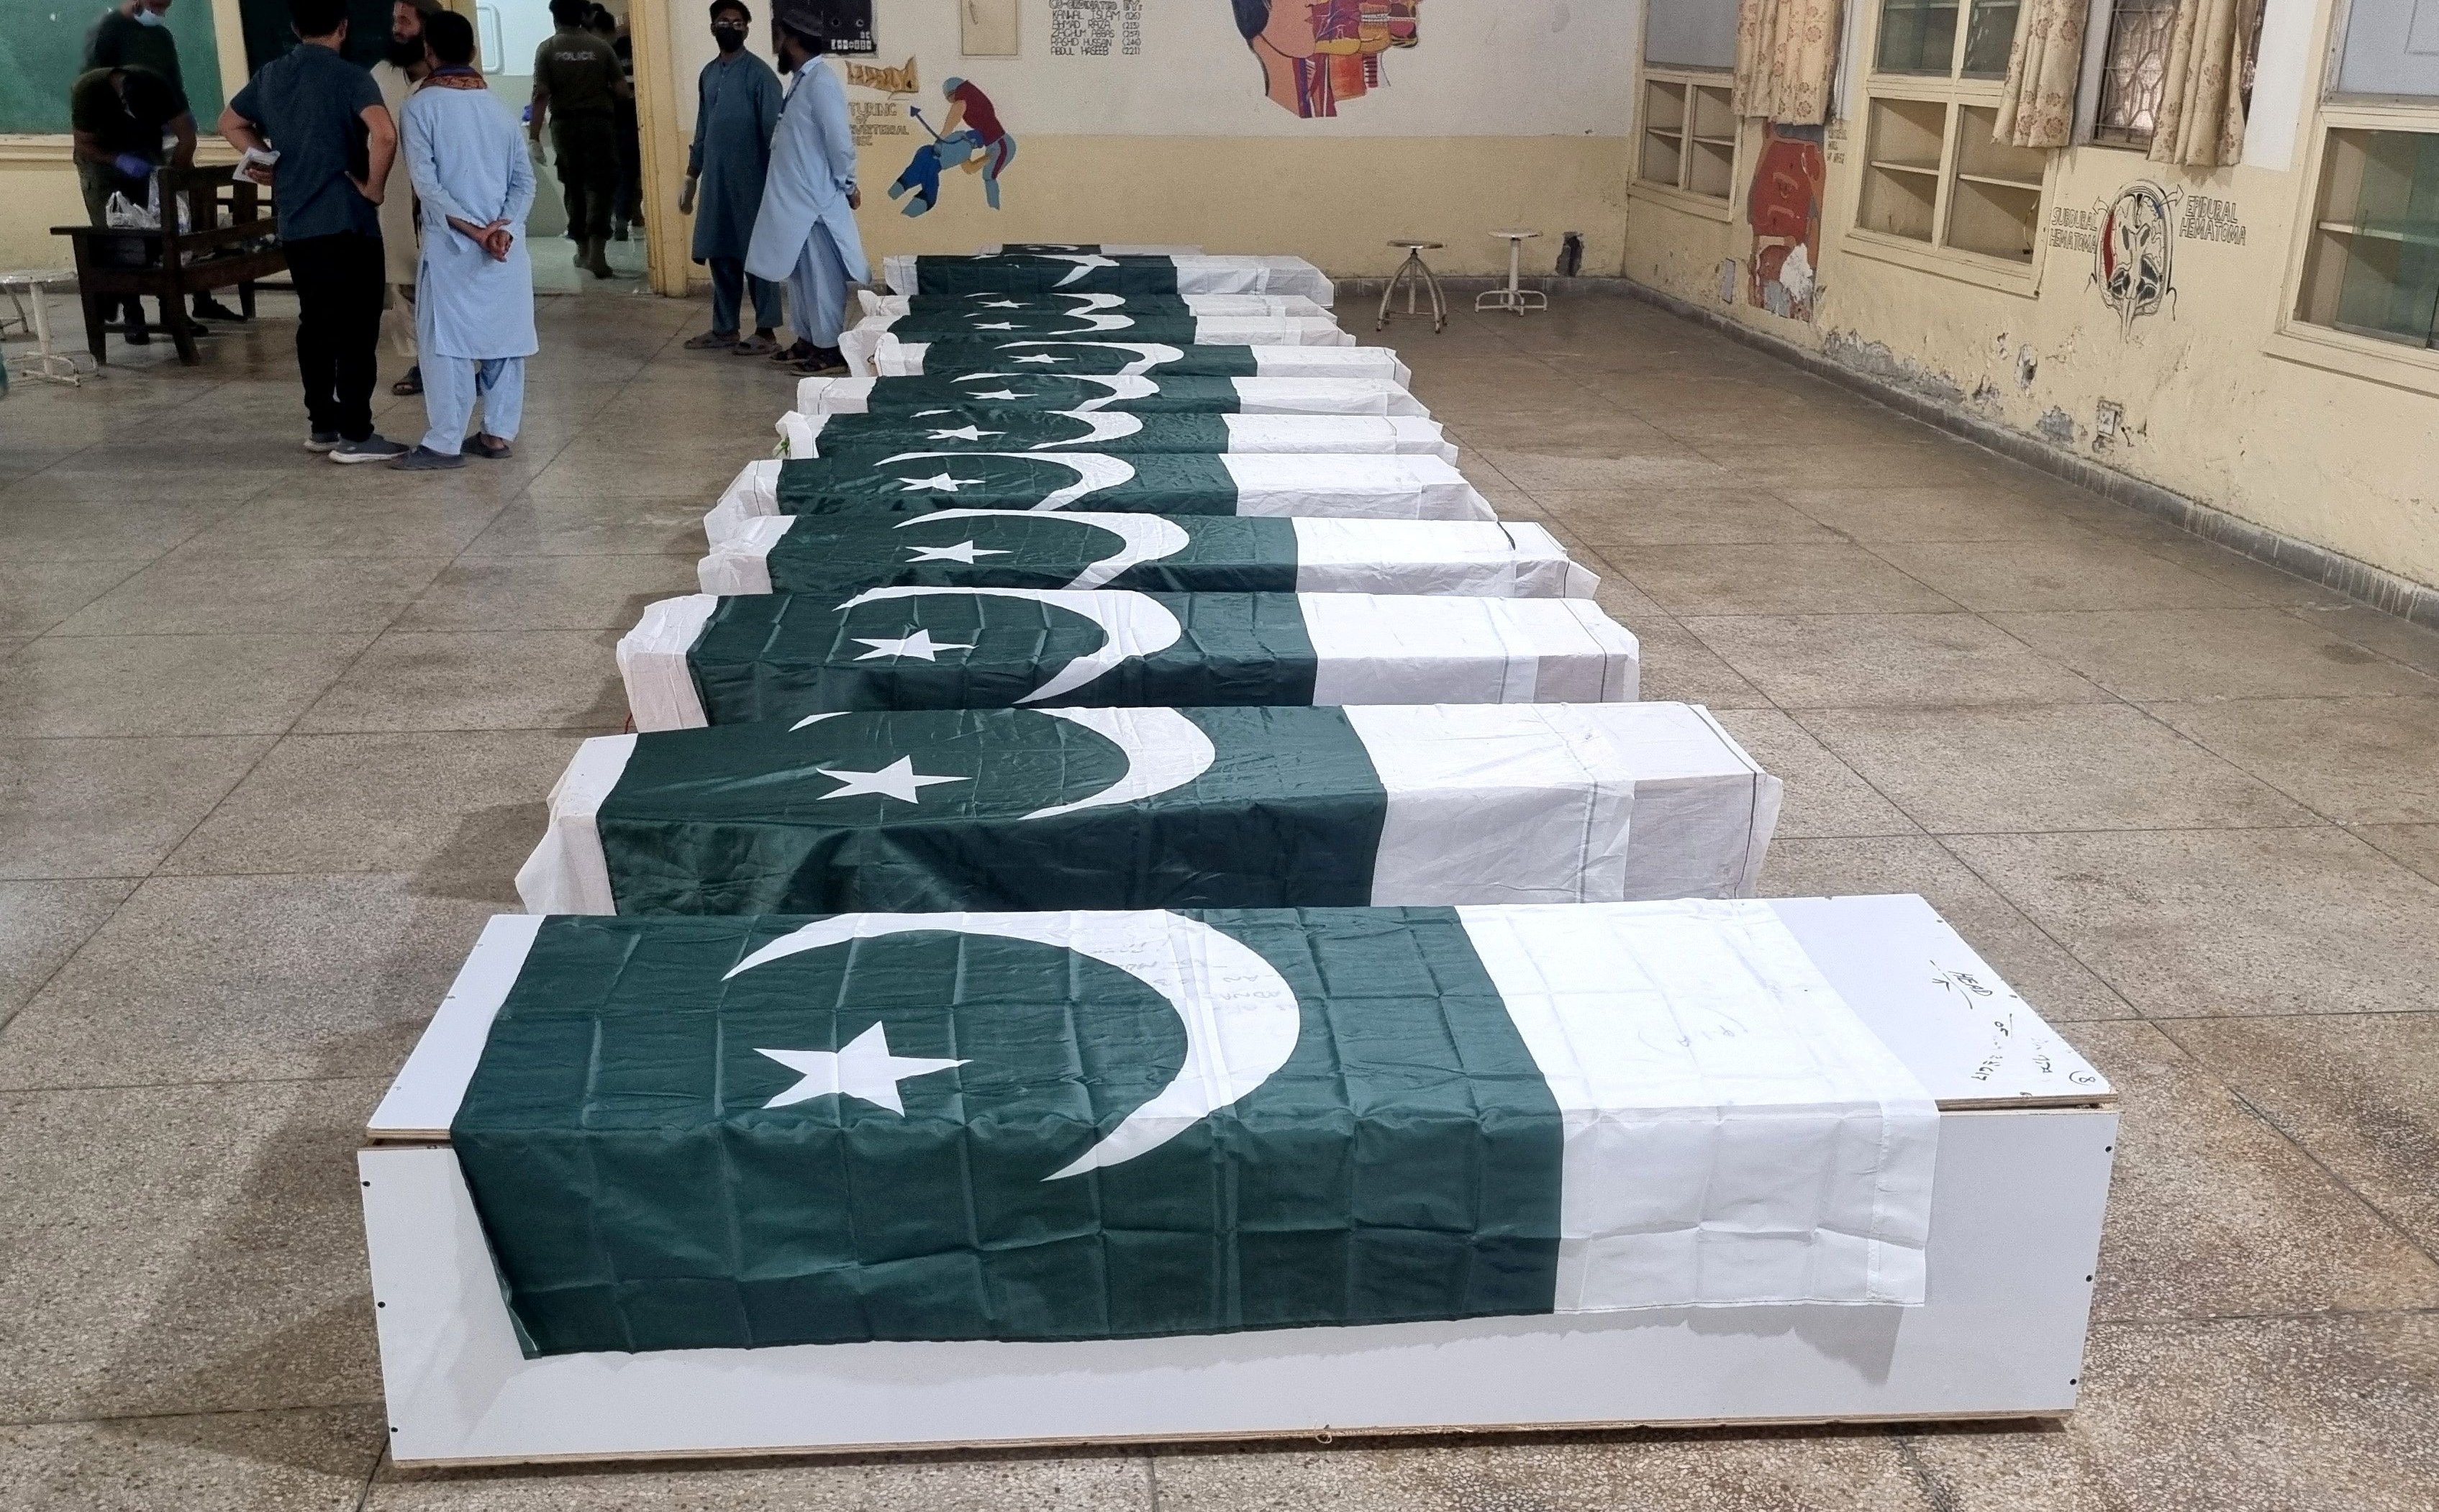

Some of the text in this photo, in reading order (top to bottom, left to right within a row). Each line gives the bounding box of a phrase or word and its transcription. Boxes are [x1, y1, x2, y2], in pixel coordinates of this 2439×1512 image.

[1052, 19, 1080, 29] AHMAD
[1088, 19, 1110, 29] RAZA
[1053, 9, 1084, 19] KANWAL
[1092, 10, 1120, 21] ISLAM
[1091, 29, 1114, 37] ABBAS
[553, 51, 596, 61] POLICE
[1051, 47, 1074, 55] ABDUL
[1081, 47, 1109, 55] HASEEB
[2051, 206, 2097, 232] SUBDURAL
[2185, 195, 2238, 224] EPIDURAL
[2048, 227, 2097, 254] HEMATOMA
[2179, 217, 2246, 246] HEMATOMA
[1948, 971, 1994, 997] HEAD
